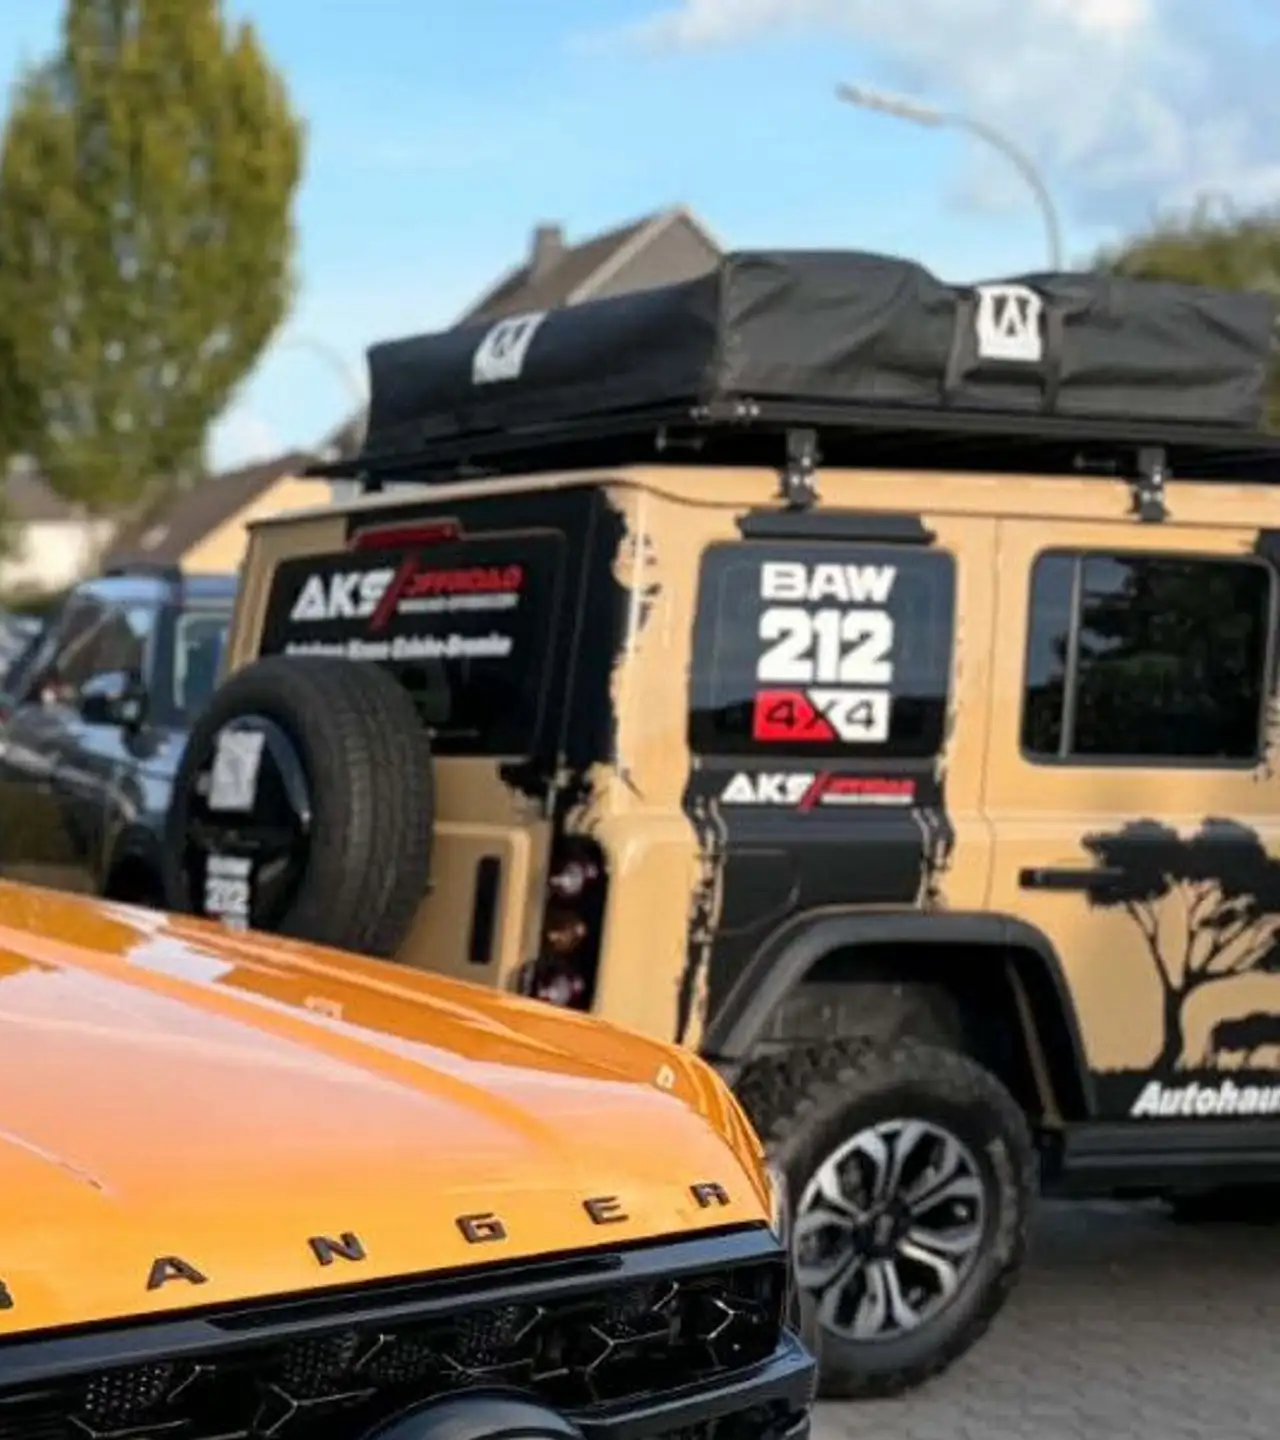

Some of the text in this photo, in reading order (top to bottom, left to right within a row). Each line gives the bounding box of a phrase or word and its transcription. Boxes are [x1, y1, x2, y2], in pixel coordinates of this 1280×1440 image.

[290, 566, 396, 622] AKS
[759, 561, 898, 604] BAW
[756, 607, 895, 685] 212
[720, 771, 816, 804] AKS
